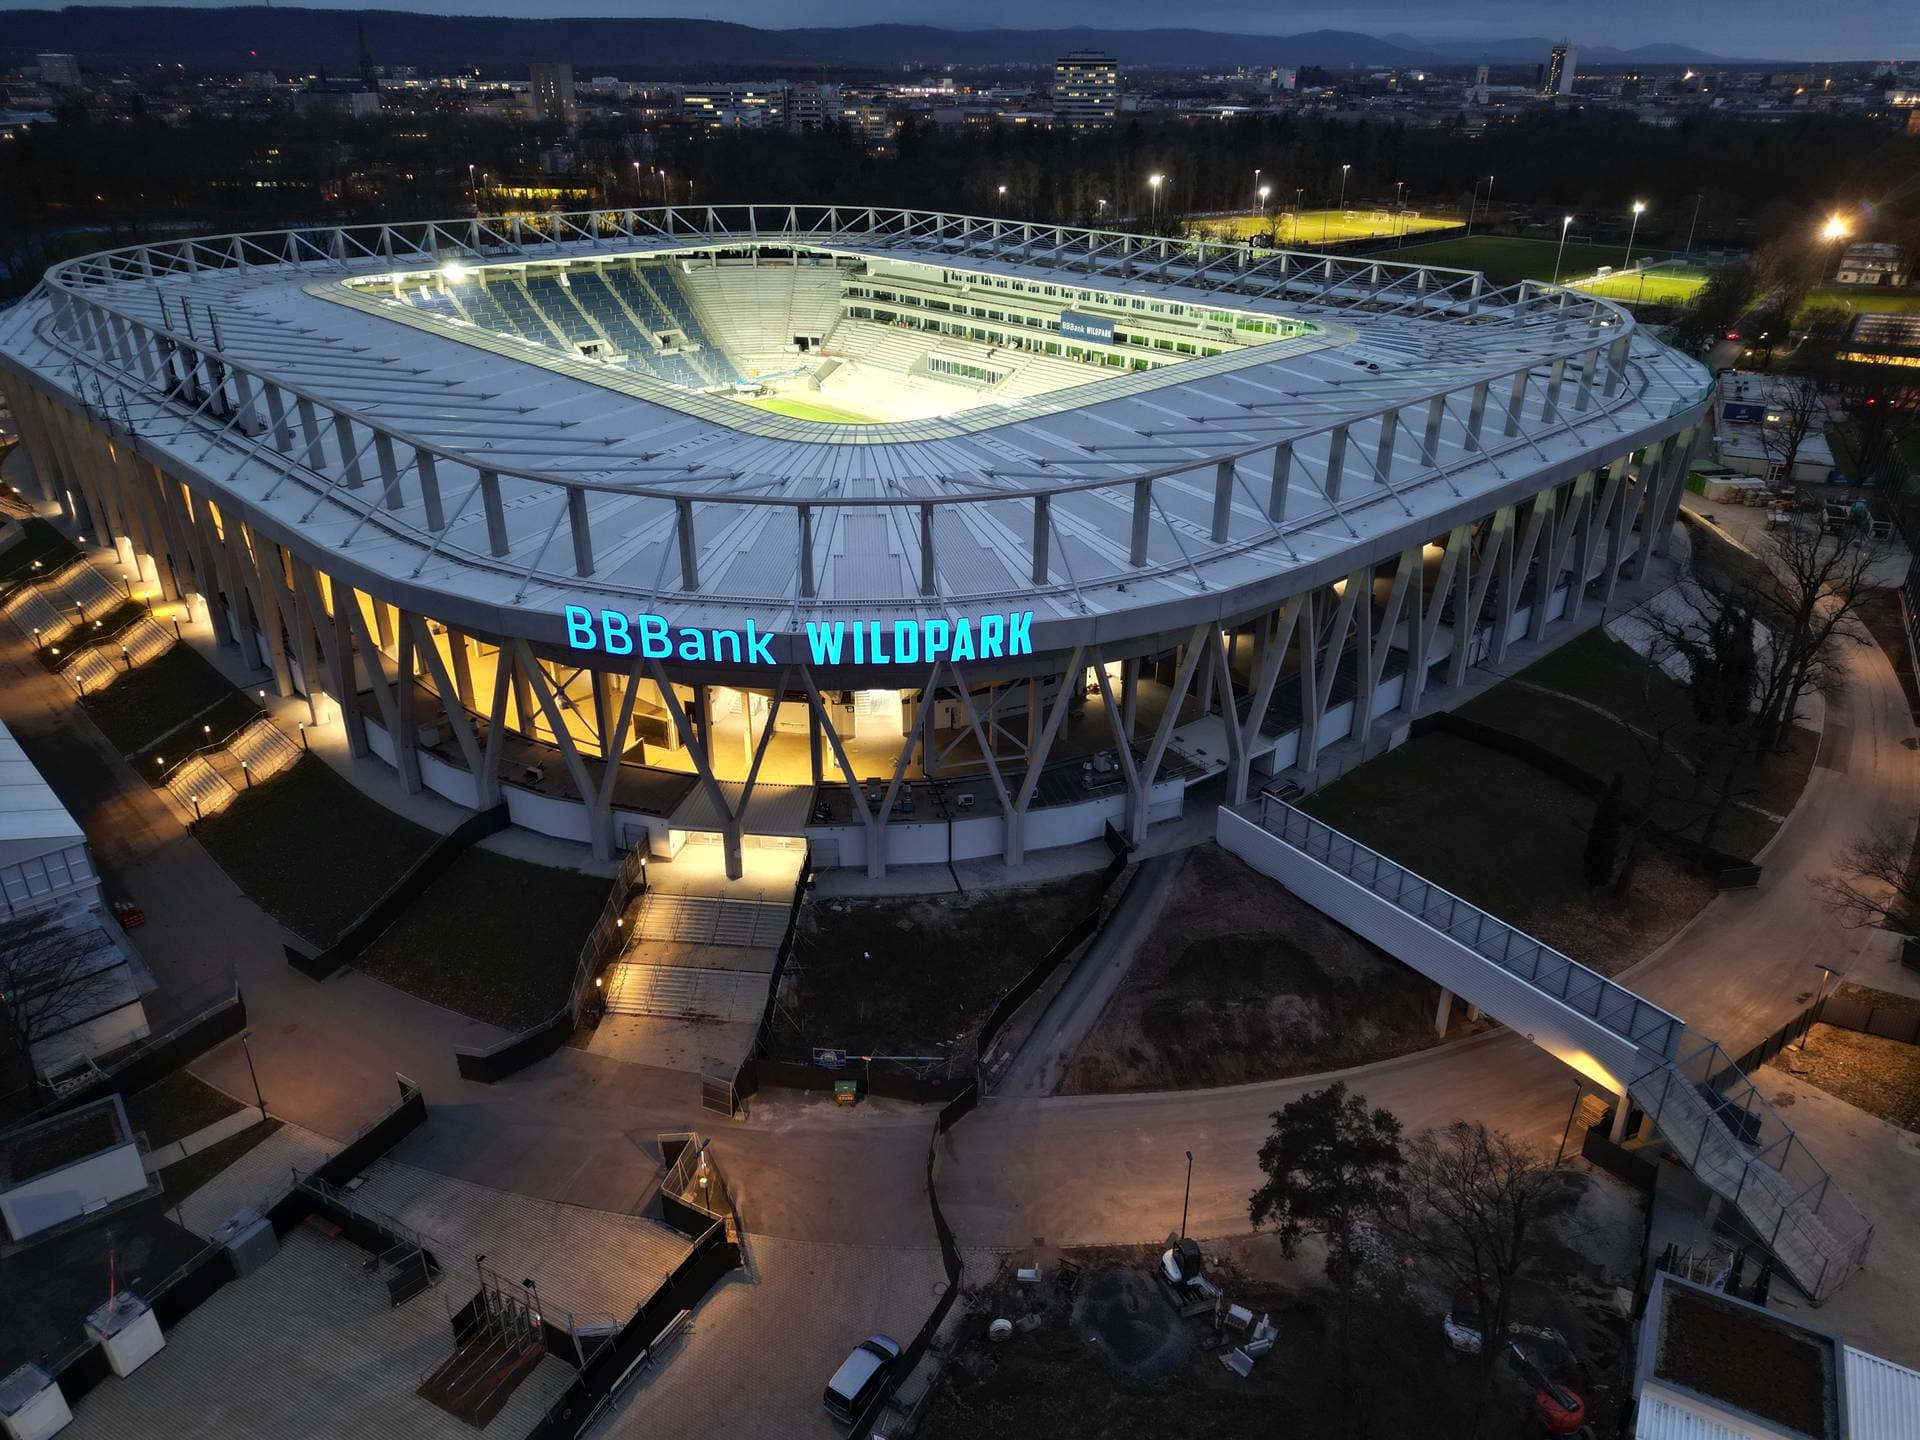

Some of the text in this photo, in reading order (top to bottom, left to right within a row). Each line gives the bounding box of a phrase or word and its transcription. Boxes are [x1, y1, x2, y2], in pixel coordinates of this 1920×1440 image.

[1062, 321, 1112, 338] BBBank WILDPARK
[564, 605, 1034, 665] BBBank WILDPARK
